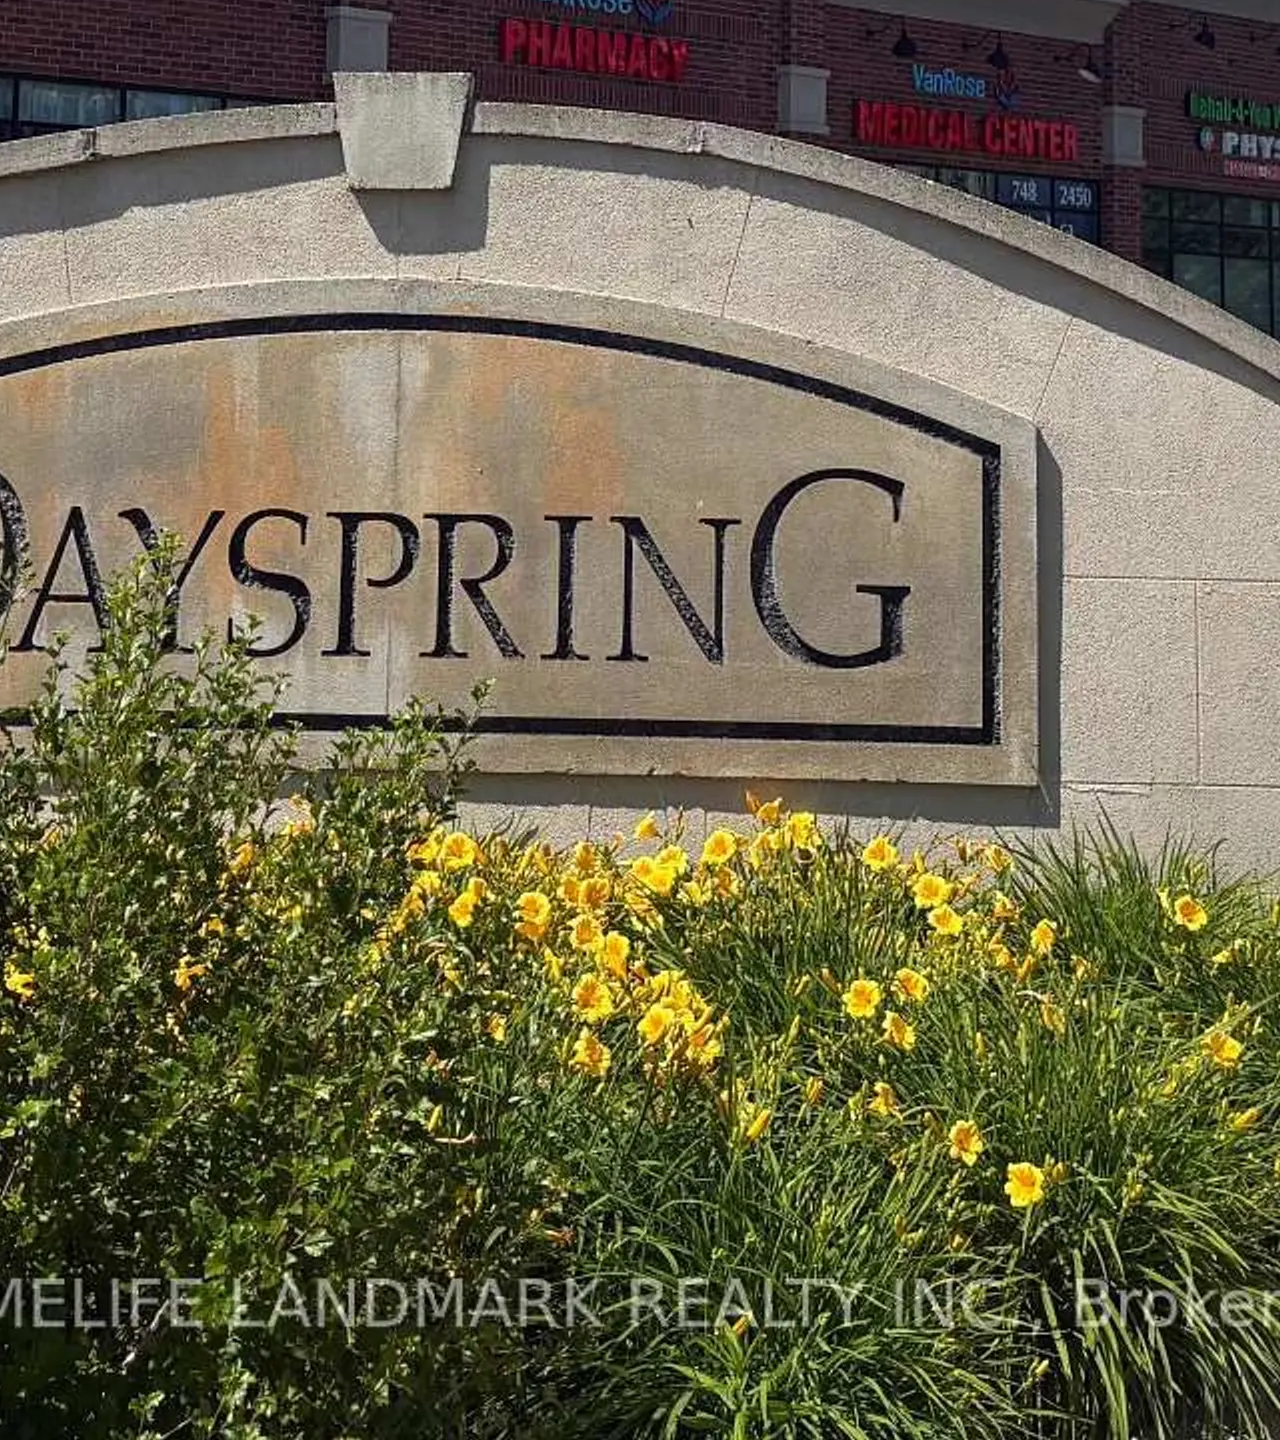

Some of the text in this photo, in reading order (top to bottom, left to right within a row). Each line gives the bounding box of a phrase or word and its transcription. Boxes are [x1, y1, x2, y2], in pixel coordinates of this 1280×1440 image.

[499, 17, 690, 81] PHARMACY
[912, 63, 986, 97] VanRose
[855, 98, 980, 151] MEDICAL
[984, 112, 1078, 162] CENTER
[1058, 185, 1092, 208] 2450
